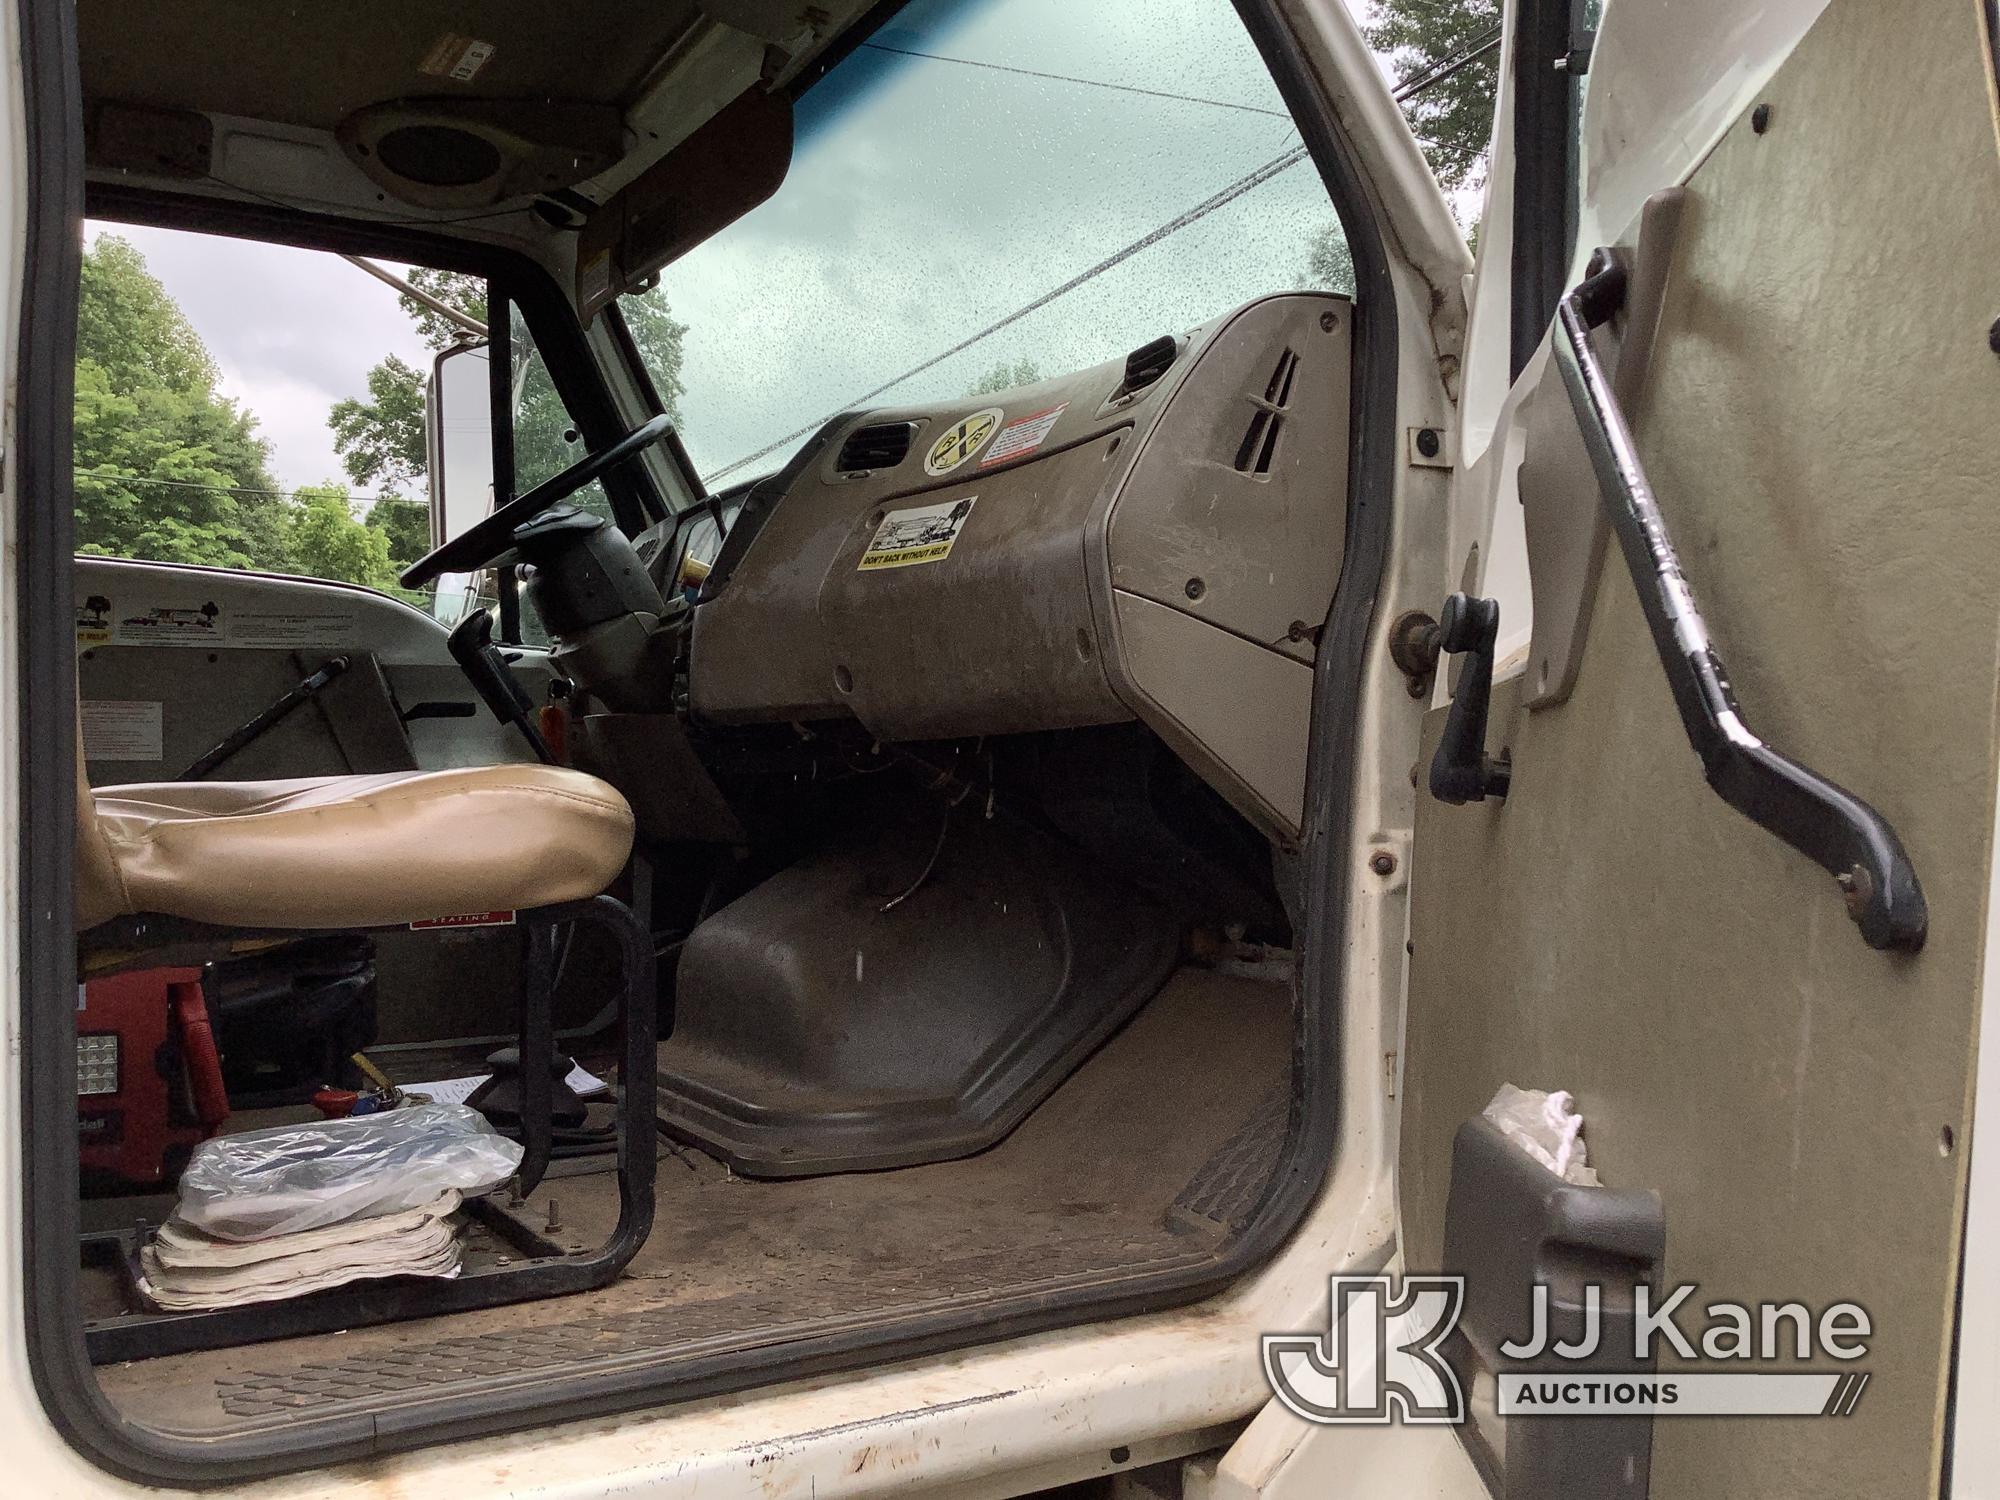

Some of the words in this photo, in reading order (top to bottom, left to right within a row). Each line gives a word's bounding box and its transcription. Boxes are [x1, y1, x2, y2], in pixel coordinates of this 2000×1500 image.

[863, 556, 884, 564] DON'T
[884, 554, 901, 562] BACK
[902, 549, 929, 561] WITHOUT
[431, 914, 489, 924] SEATING
